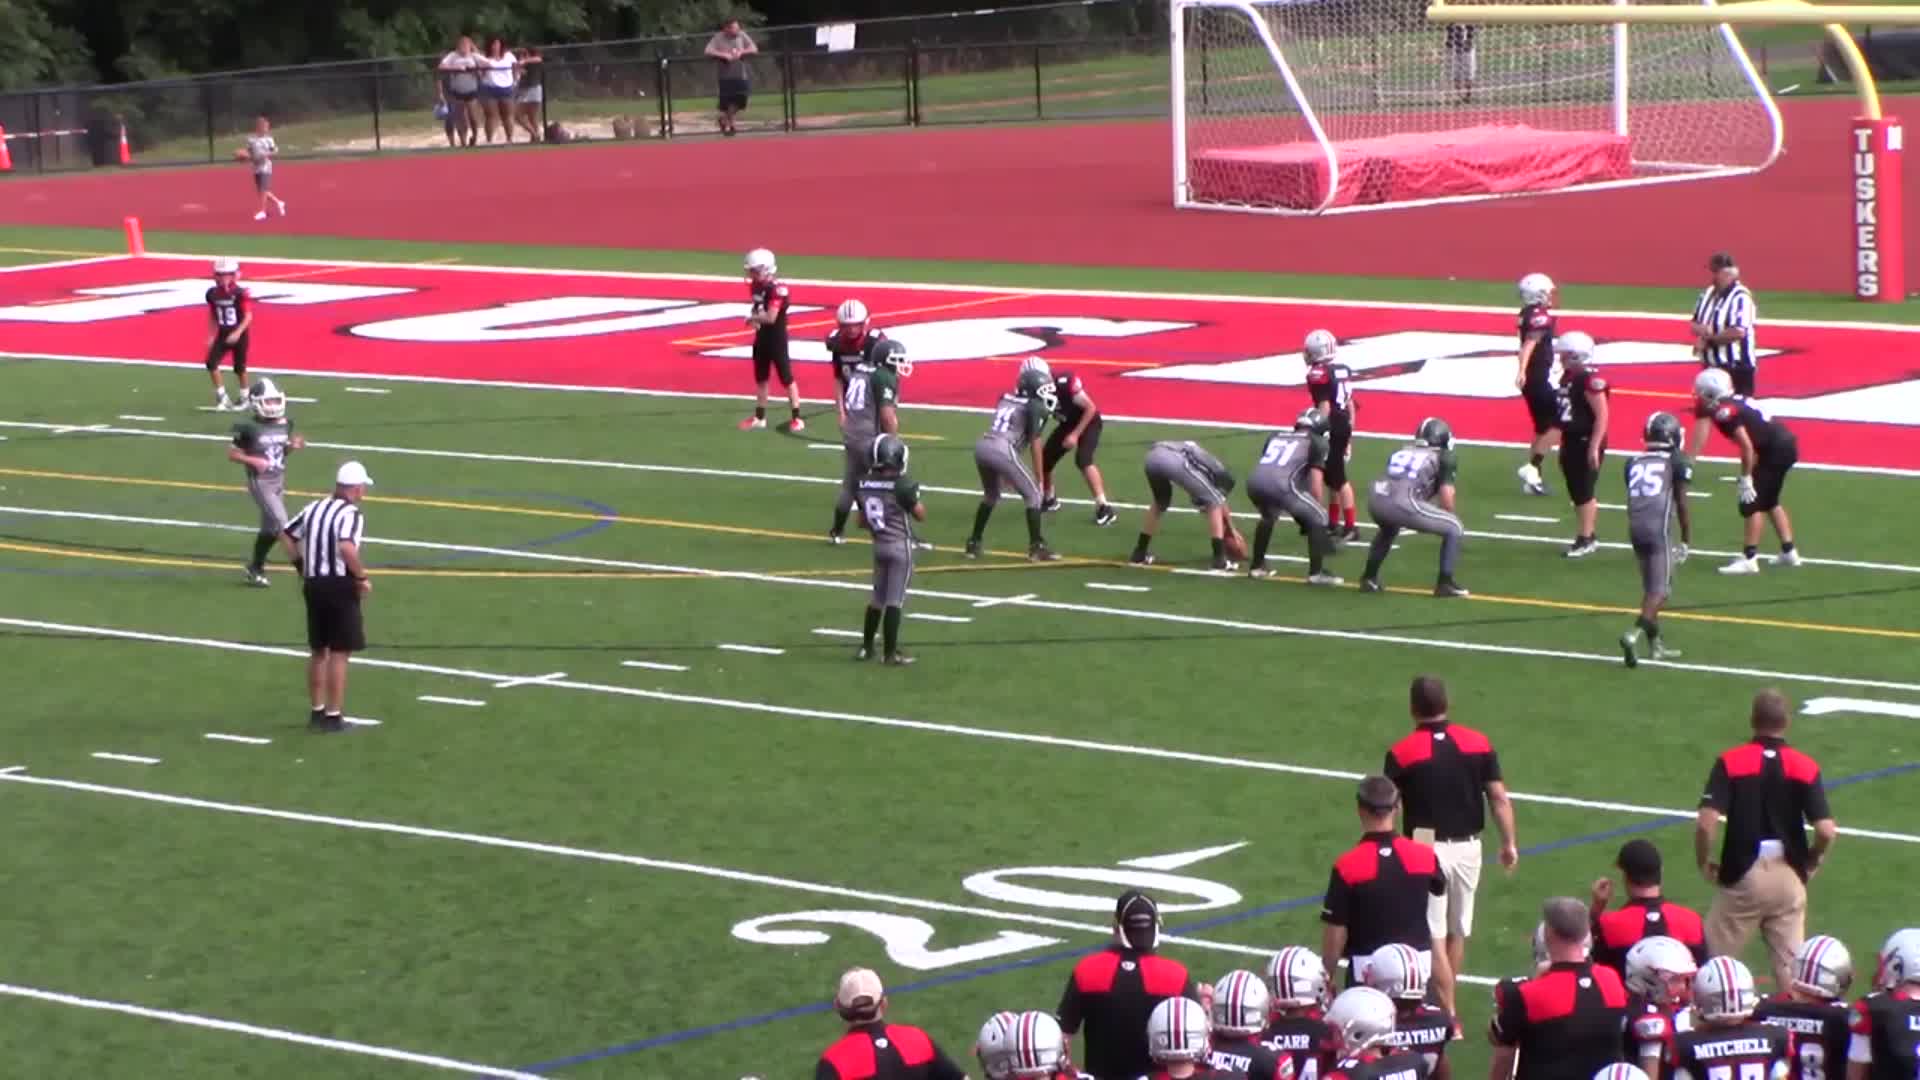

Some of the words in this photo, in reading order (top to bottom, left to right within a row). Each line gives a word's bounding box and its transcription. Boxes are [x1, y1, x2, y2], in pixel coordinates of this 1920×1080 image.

[1854, 128, 1879, 296] TUSKERS
[1260, 439, 1299, 466] 51
[1629, 463, 1666, 497] 25
[1273, 1035, 1311, 1050] CARR
[1693, 1038, 1772, 1060] MITCHELL
